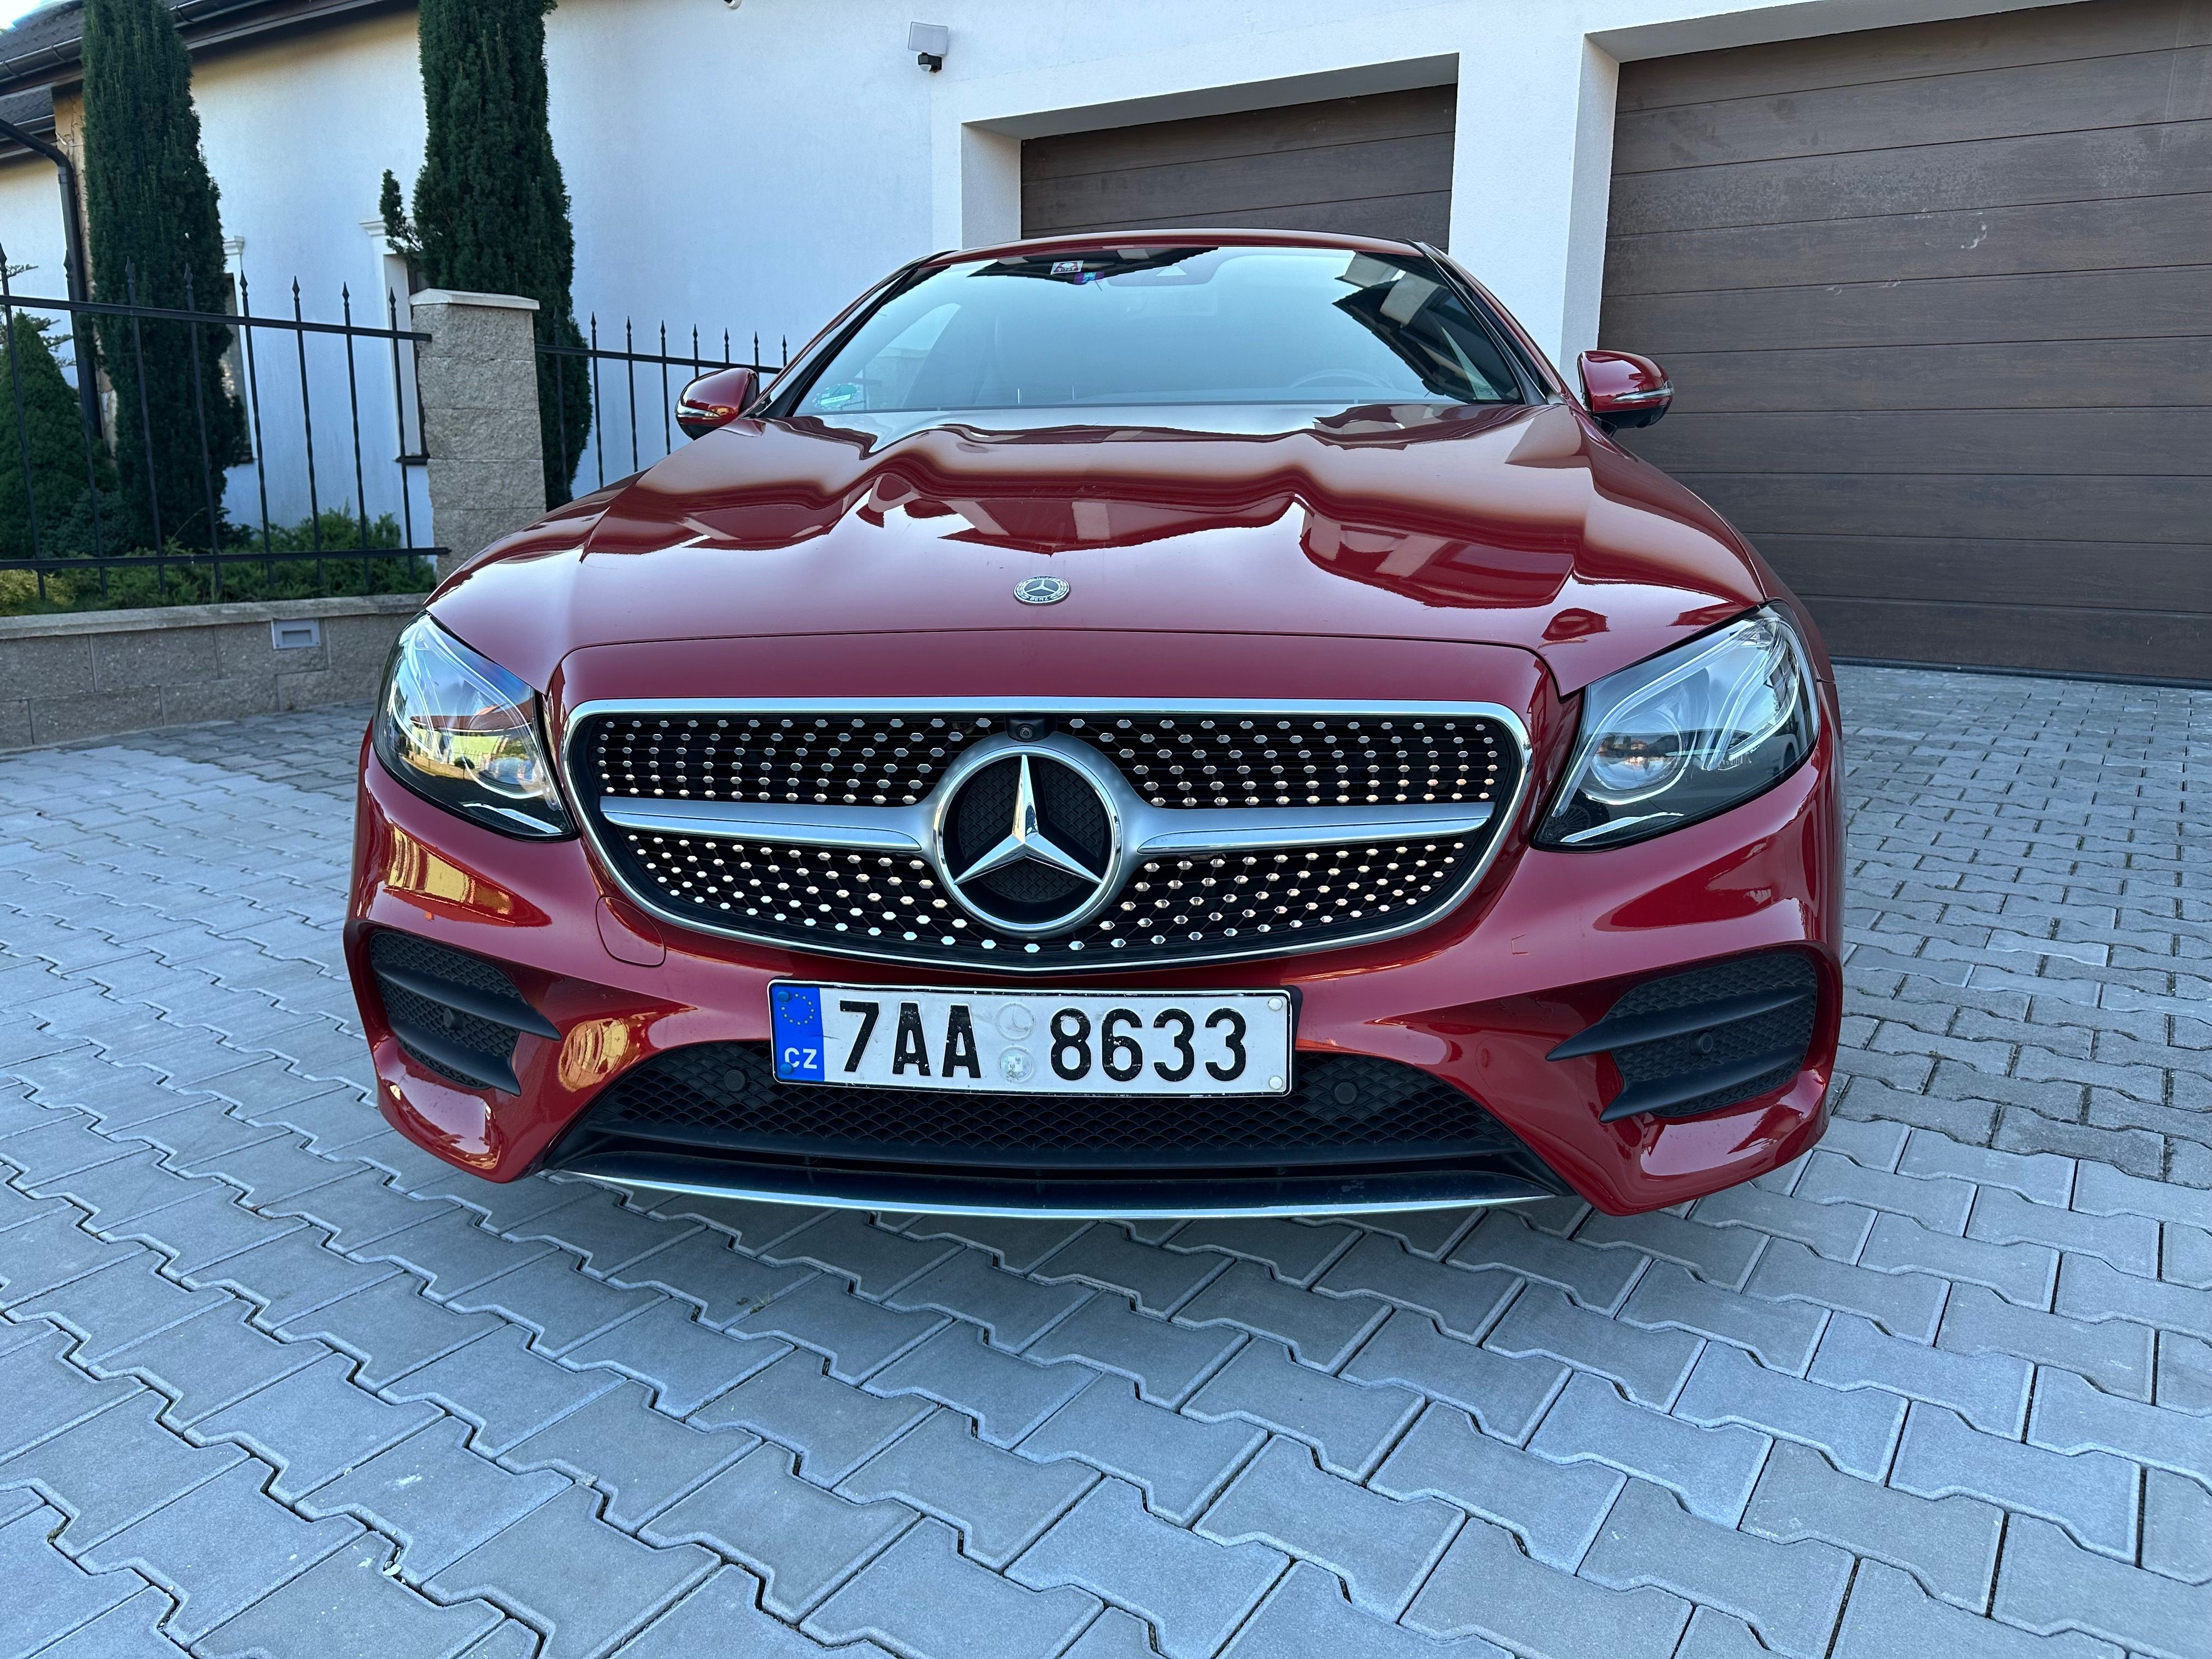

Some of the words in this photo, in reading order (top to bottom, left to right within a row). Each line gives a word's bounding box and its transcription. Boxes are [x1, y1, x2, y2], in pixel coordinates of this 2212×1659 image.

[785, 1047, 817, 1069] CZ
[839, 1000, 981, 1079] 7AA
[1050, 1008, 1246, 1082] 8633
